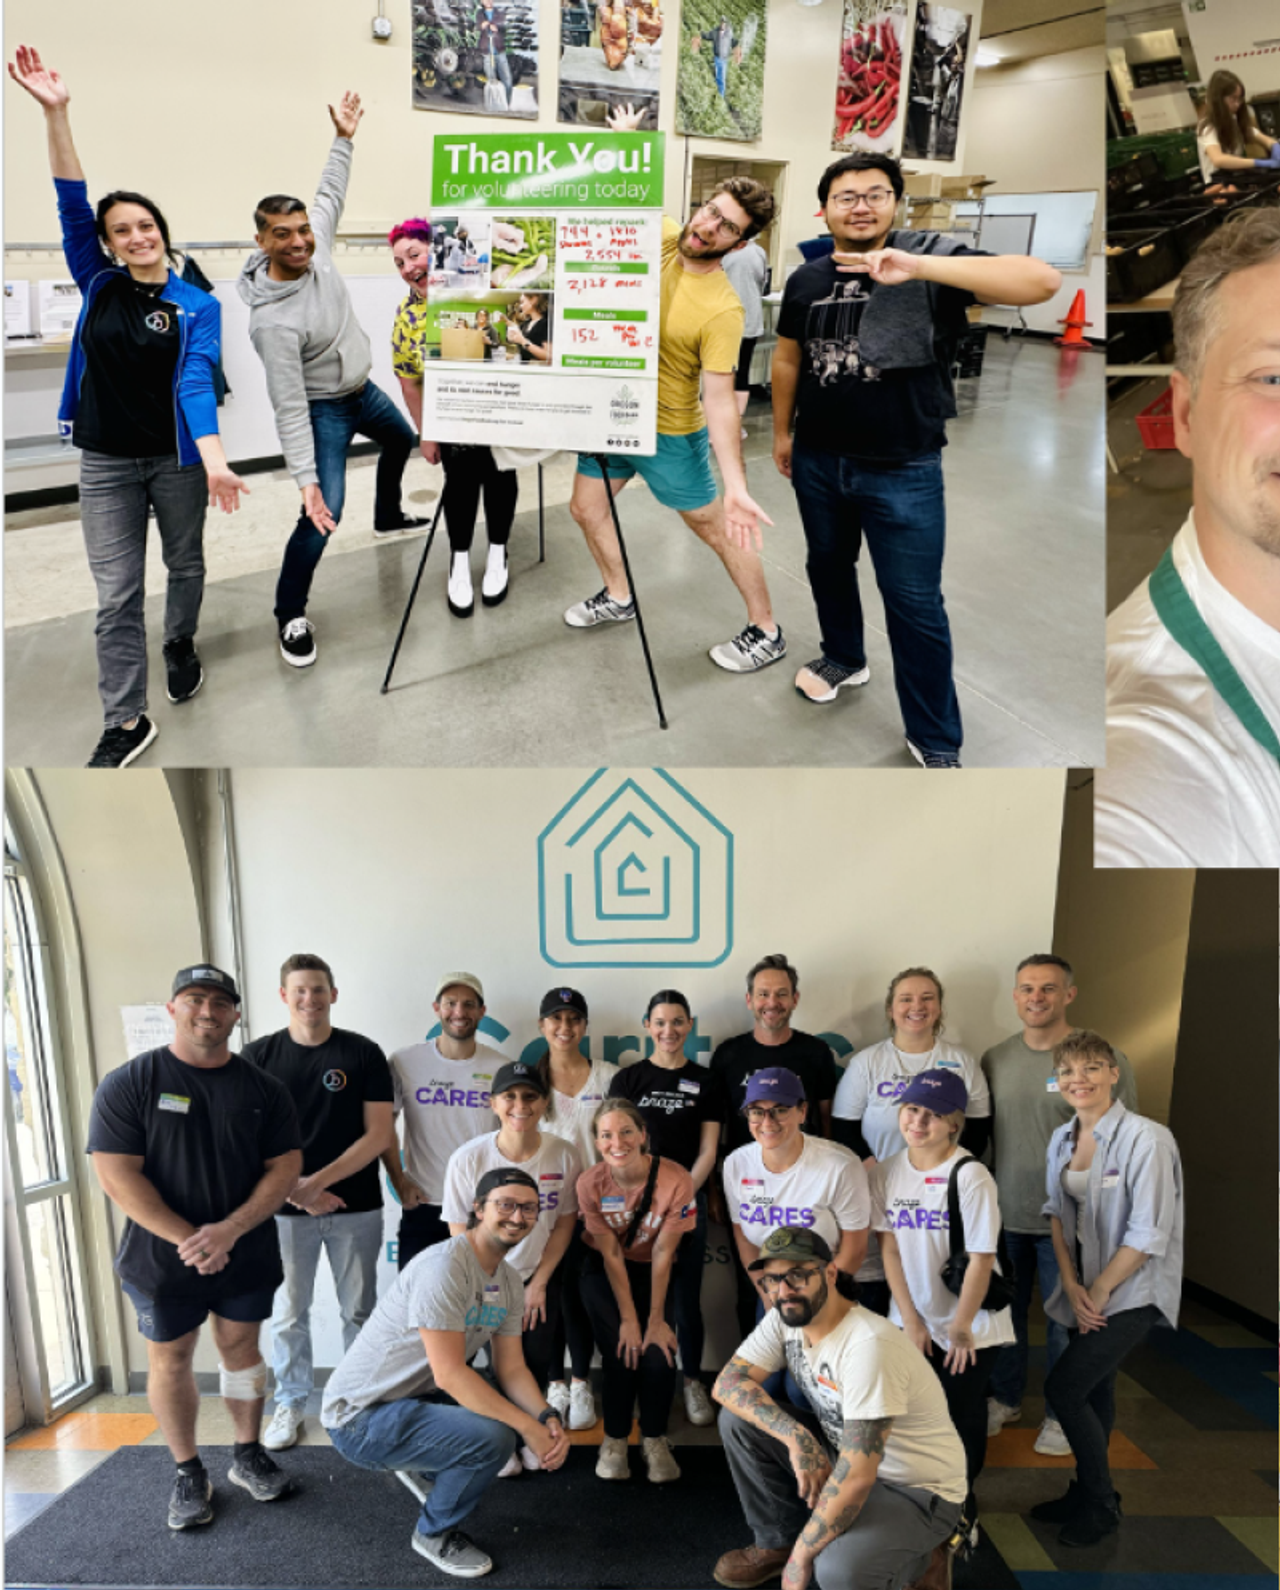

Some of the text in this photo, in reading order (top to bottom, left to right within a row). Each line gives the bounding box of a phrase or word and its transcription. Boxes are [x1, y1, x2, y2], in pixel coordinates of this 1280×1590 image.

[443, 141, 652, 174] Thank You!
[442, 180, 651, 200] for volunteering today
[593, 311, 617, 319] Meals
[572, 328, 598, 343] 152
[415, 1087, 492, 1108] CARES
[638, 1095, 684, 1114] braze
[739, 1203, 816, 1228] CARES
[886, 1208, 950, 1230] CARES
